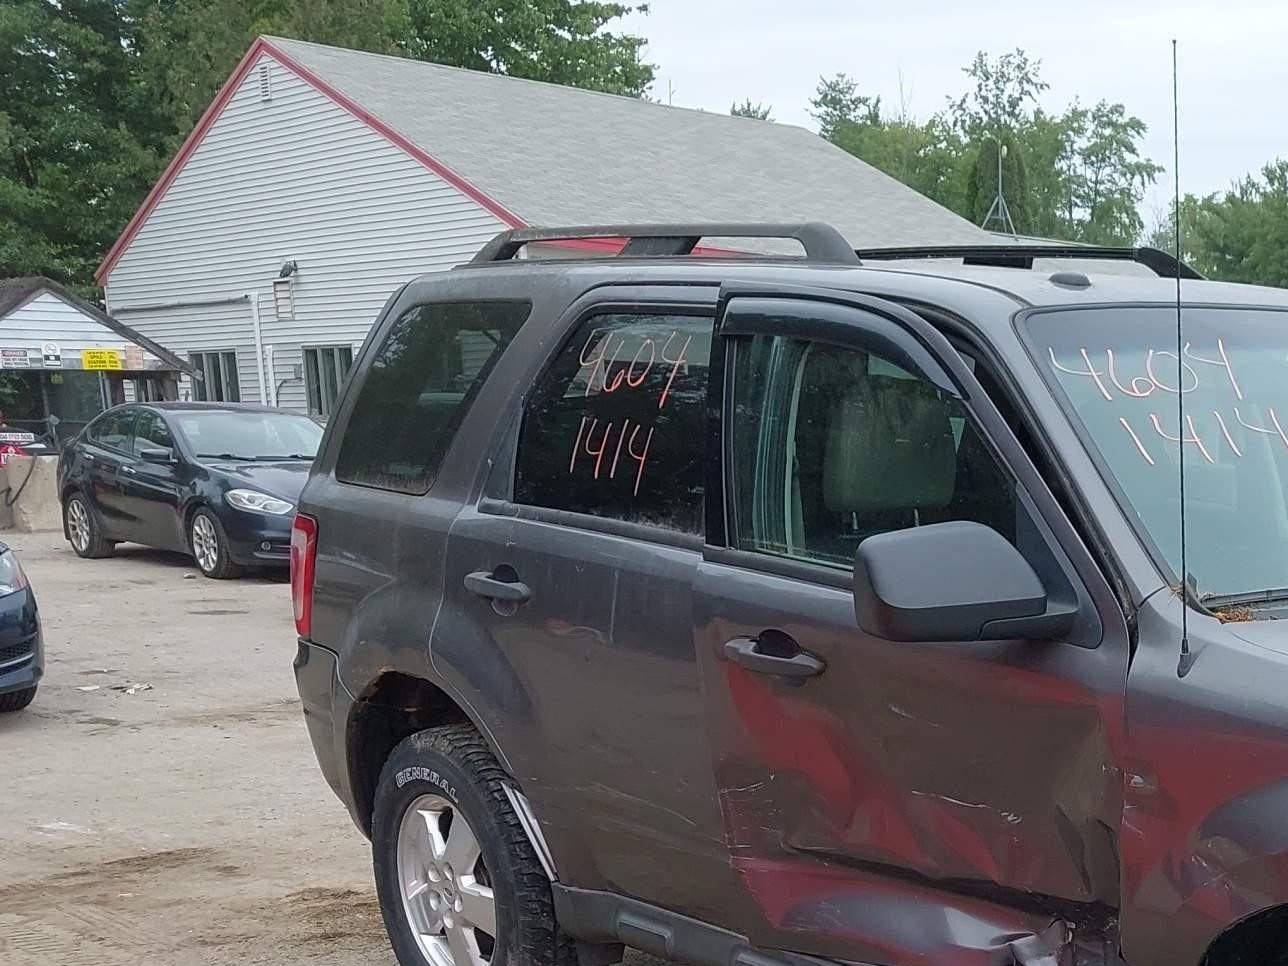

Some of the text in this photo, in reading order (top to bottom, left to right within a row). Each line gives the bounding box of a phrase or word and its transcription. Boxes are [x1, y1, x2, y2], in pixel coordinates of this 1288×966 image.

[579, 328, 692, 409] 4604
[1048, 338, 1243, 401] 4604
[569, 416, 654, 497] 1414
[395, 766, 459, 804] GENERAL
